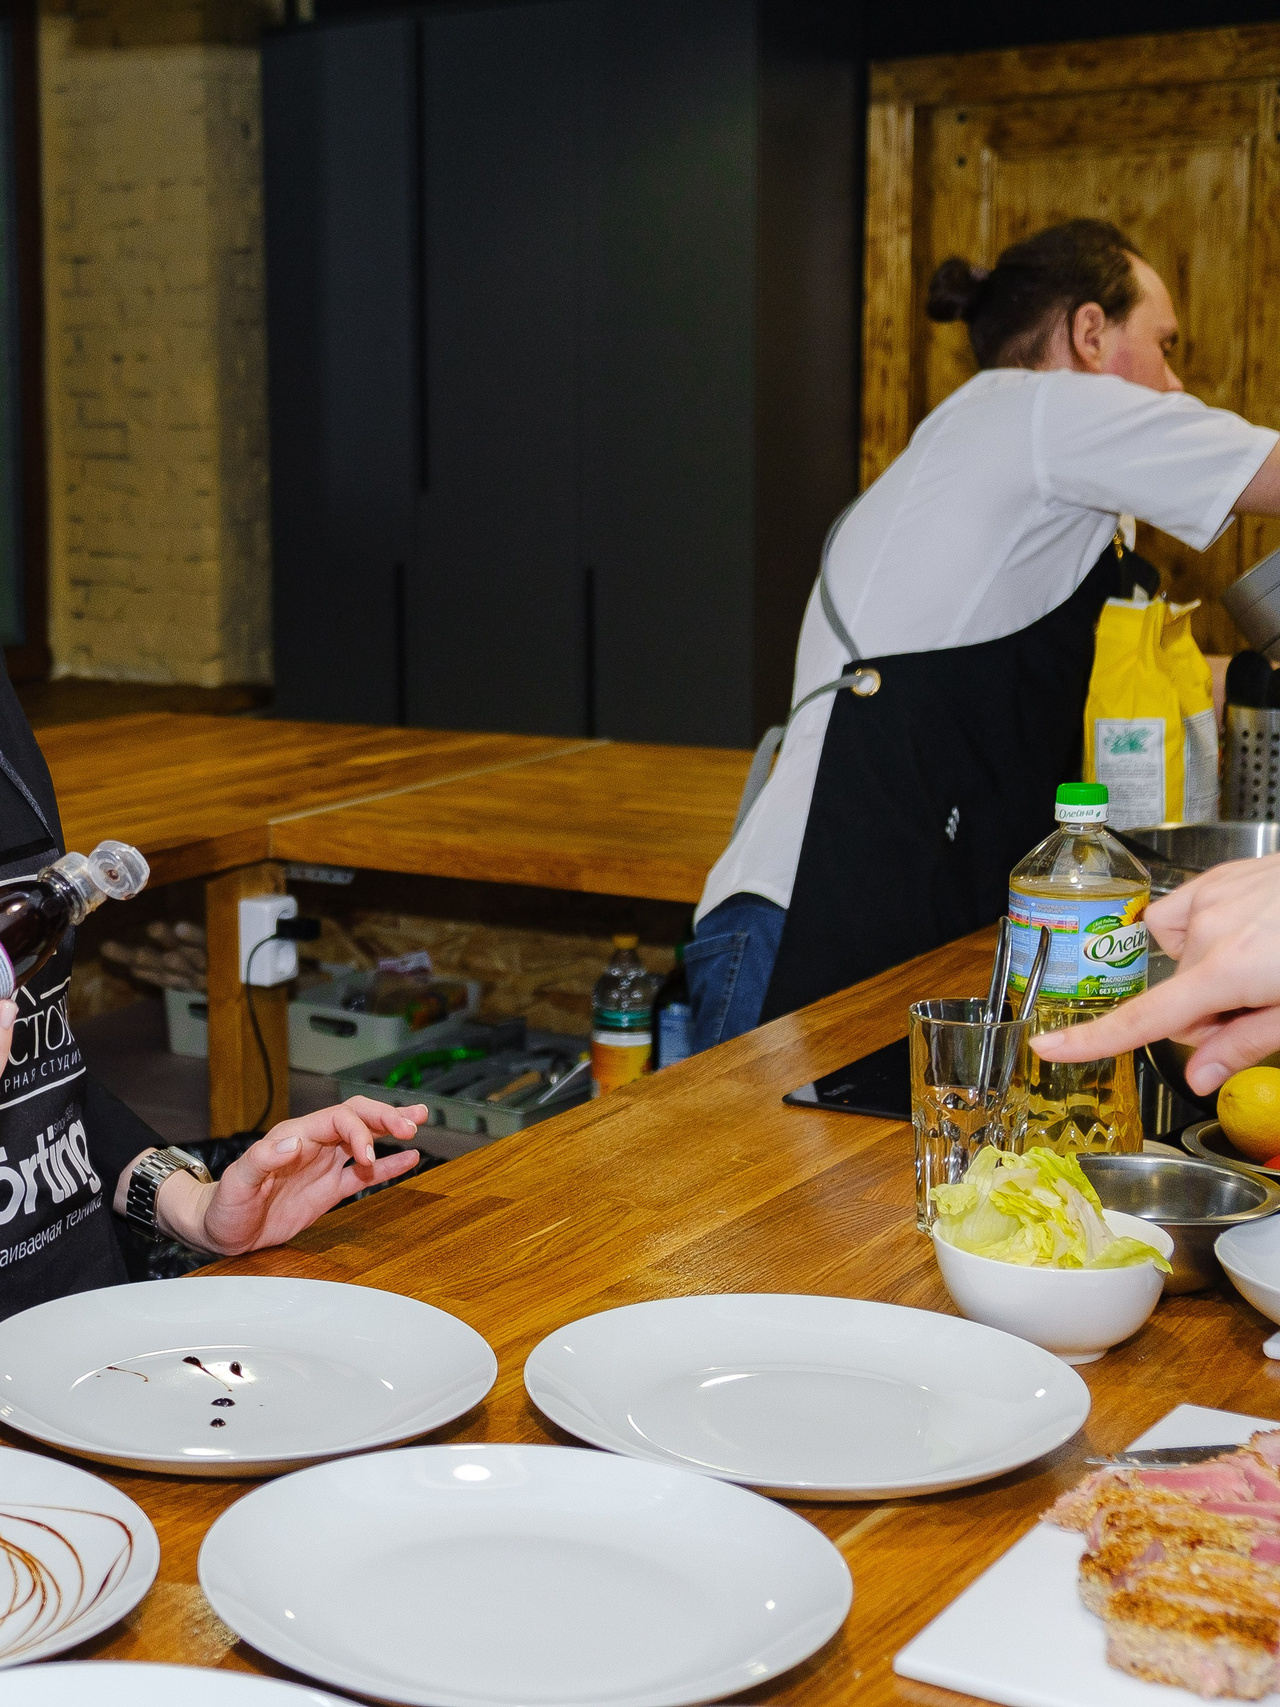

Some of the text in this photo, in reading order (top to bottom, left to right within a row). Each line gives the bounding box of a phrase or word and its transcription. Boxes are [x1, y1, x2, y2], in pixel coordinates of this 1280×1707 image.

[1059, 808, 1094, 819] Олейна
[1091, 928, 1148, 960] Олейн
[65, 1192, 104, 1231] техника
